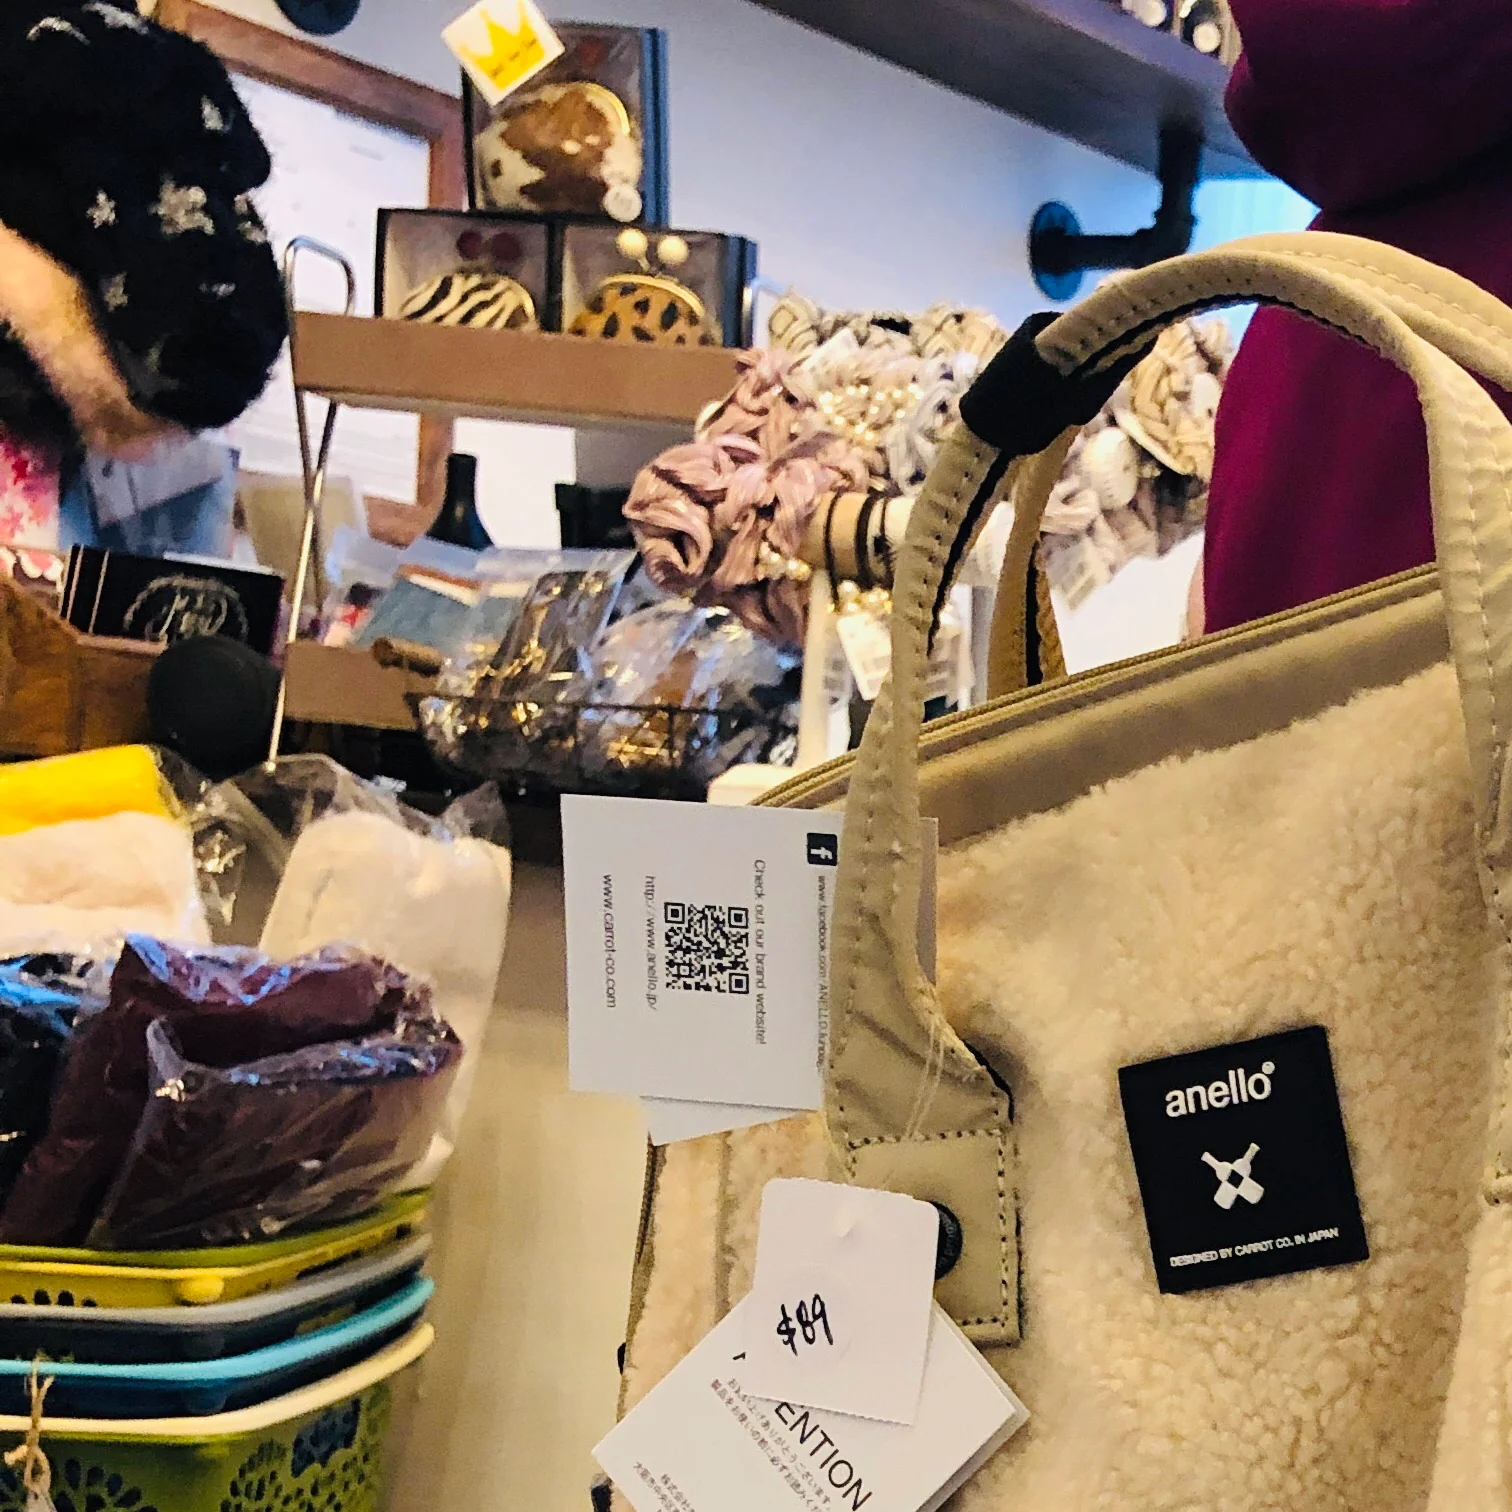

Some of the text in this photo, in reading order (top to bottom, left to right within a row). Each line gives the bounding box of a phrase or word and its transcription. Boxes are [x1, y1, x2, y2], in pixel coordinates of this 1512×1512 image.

[754, 859, 766, 900] Check
[755, 904, 765, 924] out
[603, 874, 617, 1008] www.carrot-co.com
[755, 928, 765, 949] our
[755, 952, 767, 989] brand
[1165, 1067, 1272, 1117] anello
[1169, 1250, 1218, 1267] DESIGNED
[1219, 1247, 1233, 1259] BY
[1234, 1239, 1274, 1257] CARROT
[1294, 1233, 1306, 1244] IN
[1307, 1227, 1340, 1243] JAPAN
